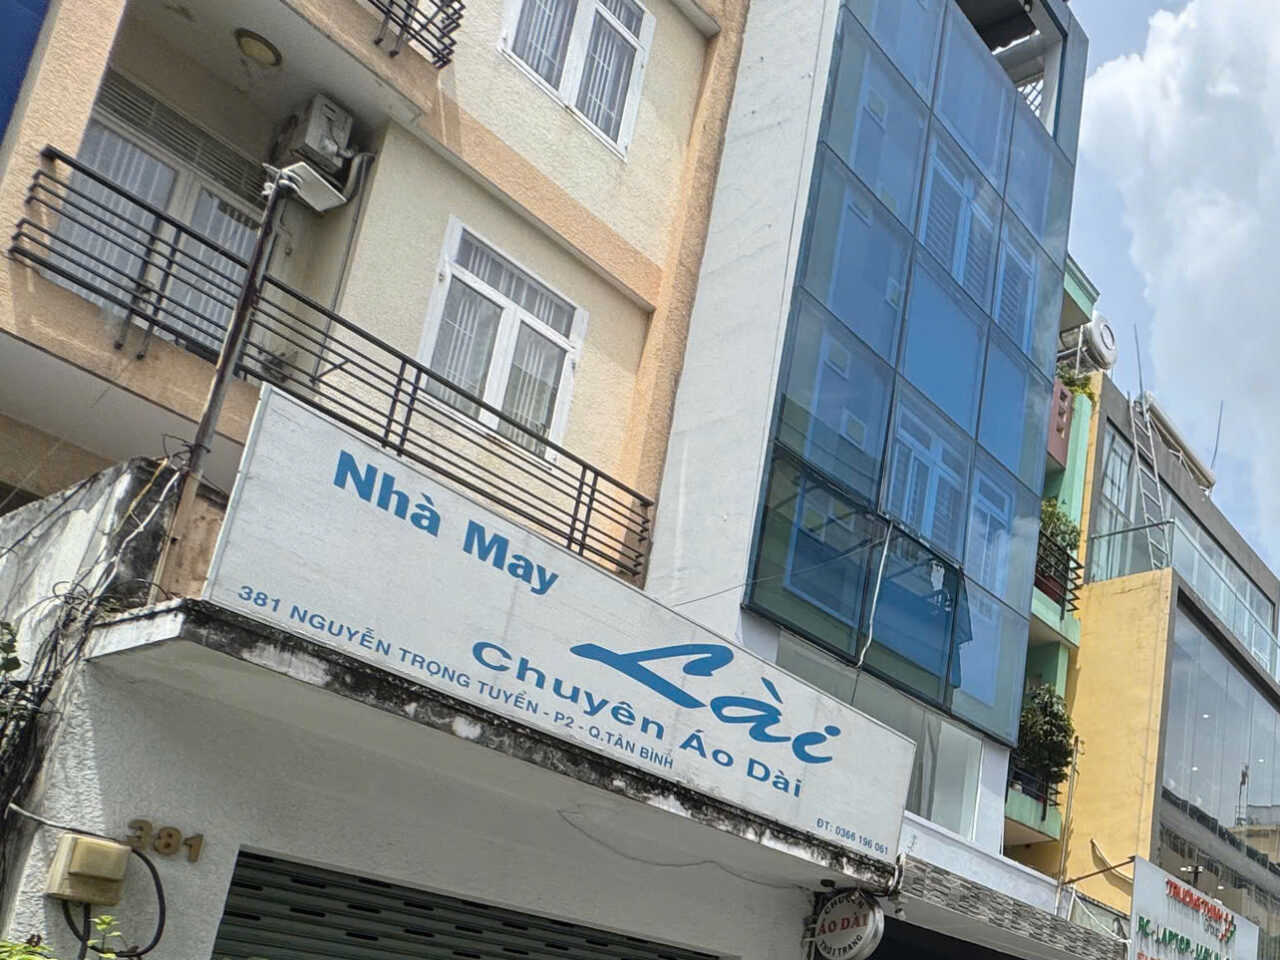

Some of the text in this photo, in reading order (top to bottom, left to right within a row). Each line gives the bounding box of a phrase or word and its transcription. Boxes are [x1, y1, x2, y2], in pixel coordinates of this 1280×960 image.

[332, 448, 560, 598] Nhà May
[237, 585, 281, 613] 381
[290, 604, 391, 657] NGUYỄN
[398, 646, 470, 690] TRỌNG
[477, 679, 539, 716] TUYỂN
[553, 710, 575, 730] P2
[639, 743, 675, 770] BÌNH
[471, 640, 803, 799] Chuyên Áo Dài
[570, 643, 842, 766] Lài
[126, 818, 205, 863] 381
[834, 825, 857, 842] 0366
[858, 835, 874, 849] 196
[818, 911, 869, 936] ÁO DÀI
[838, 934, 864, 956] TRANG
[1136, 915, 1151, 938] PC
[1155, 925, 1191, 953] LAPTOP
